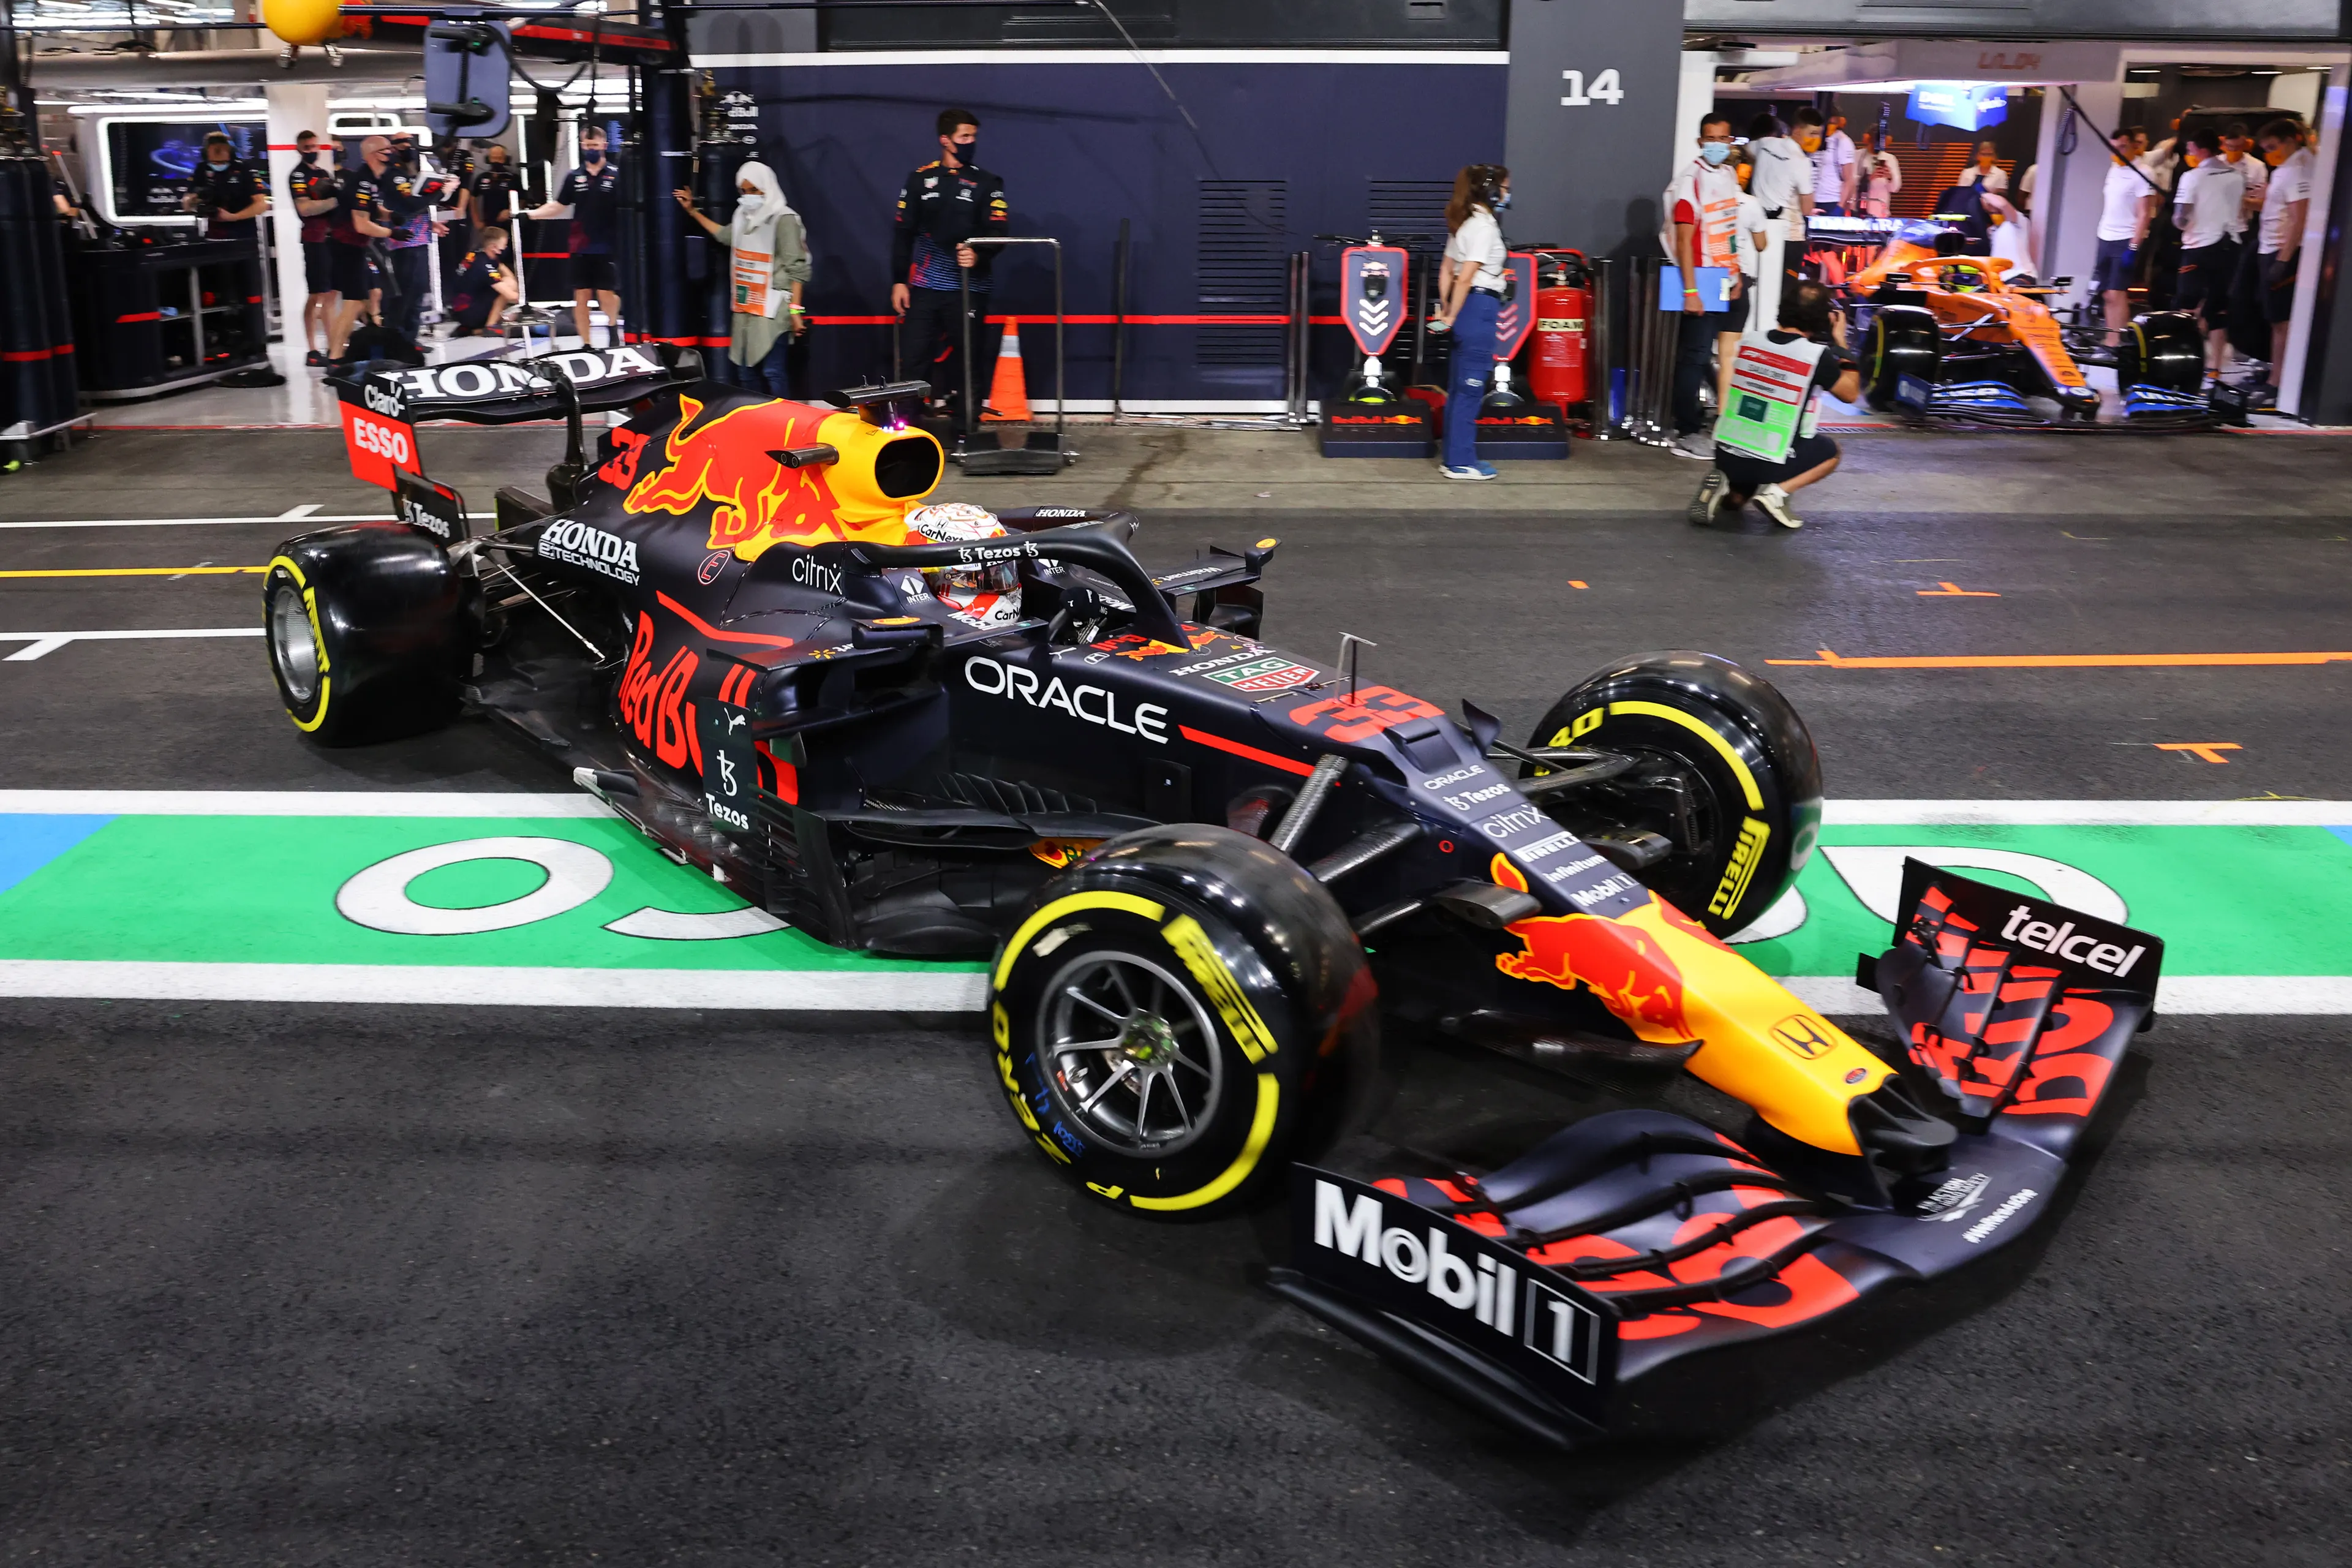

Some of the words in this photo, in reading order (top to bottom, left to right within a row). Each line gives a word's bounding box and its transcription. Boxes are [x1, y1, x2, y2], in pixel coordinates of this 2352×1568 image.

[1561, 69, 1624, 106] 14
[1538, 320, 1585, 330] FOAM
[377, 347, 665, 399] HONDA
[364, 380, 405, 417] Claro
[353, 417, 409, 464] ESSO
[412, 501, 451, 538] Tezos
[1035, 508, 1087, 518] HONDA
[541, 519, 640, 573] HONDA
[974, 546, 1022, 560] Tezos
[792, 554, 843, 595] citrix
[1043, 566, 1066, 577] INTER
[1157, 567, 1223, 581] Walmart
[906, 593, 931, 604] INTER
[995, 607, 1022, 620] CarN
[1098, 593, 1136, 611] Mob
[946, 611, 999, 631] Mobil
[1168, 648, 1276, 677] HONDA
[1215, 660, 1288, 682] TAG
[1236, 668, 1312, 691] HEUER
[964, 655, 1169, 744] ORACLE
[1289, 685, 1446, 743] 33
[1423, 764, 1486, 790] ORACLE
[1464, 782, 1512, 805] Tezos
[705, 793, 750, 831] Tezos
[1482, 804, 1552, 839] citrix
[1512, 830, 1582, 862] PIRELLI
[1542, 854, 1608, 884] infinitum
[1708, 816, 1771, 921] PIRELLI
[1569, 877, 1621, 908] Mobil
[2000, 905, 2146, 978] telcel
[1314, 1178, 1517, 1337] Mobil
[1547, 1300, 1574, 1363] 1
